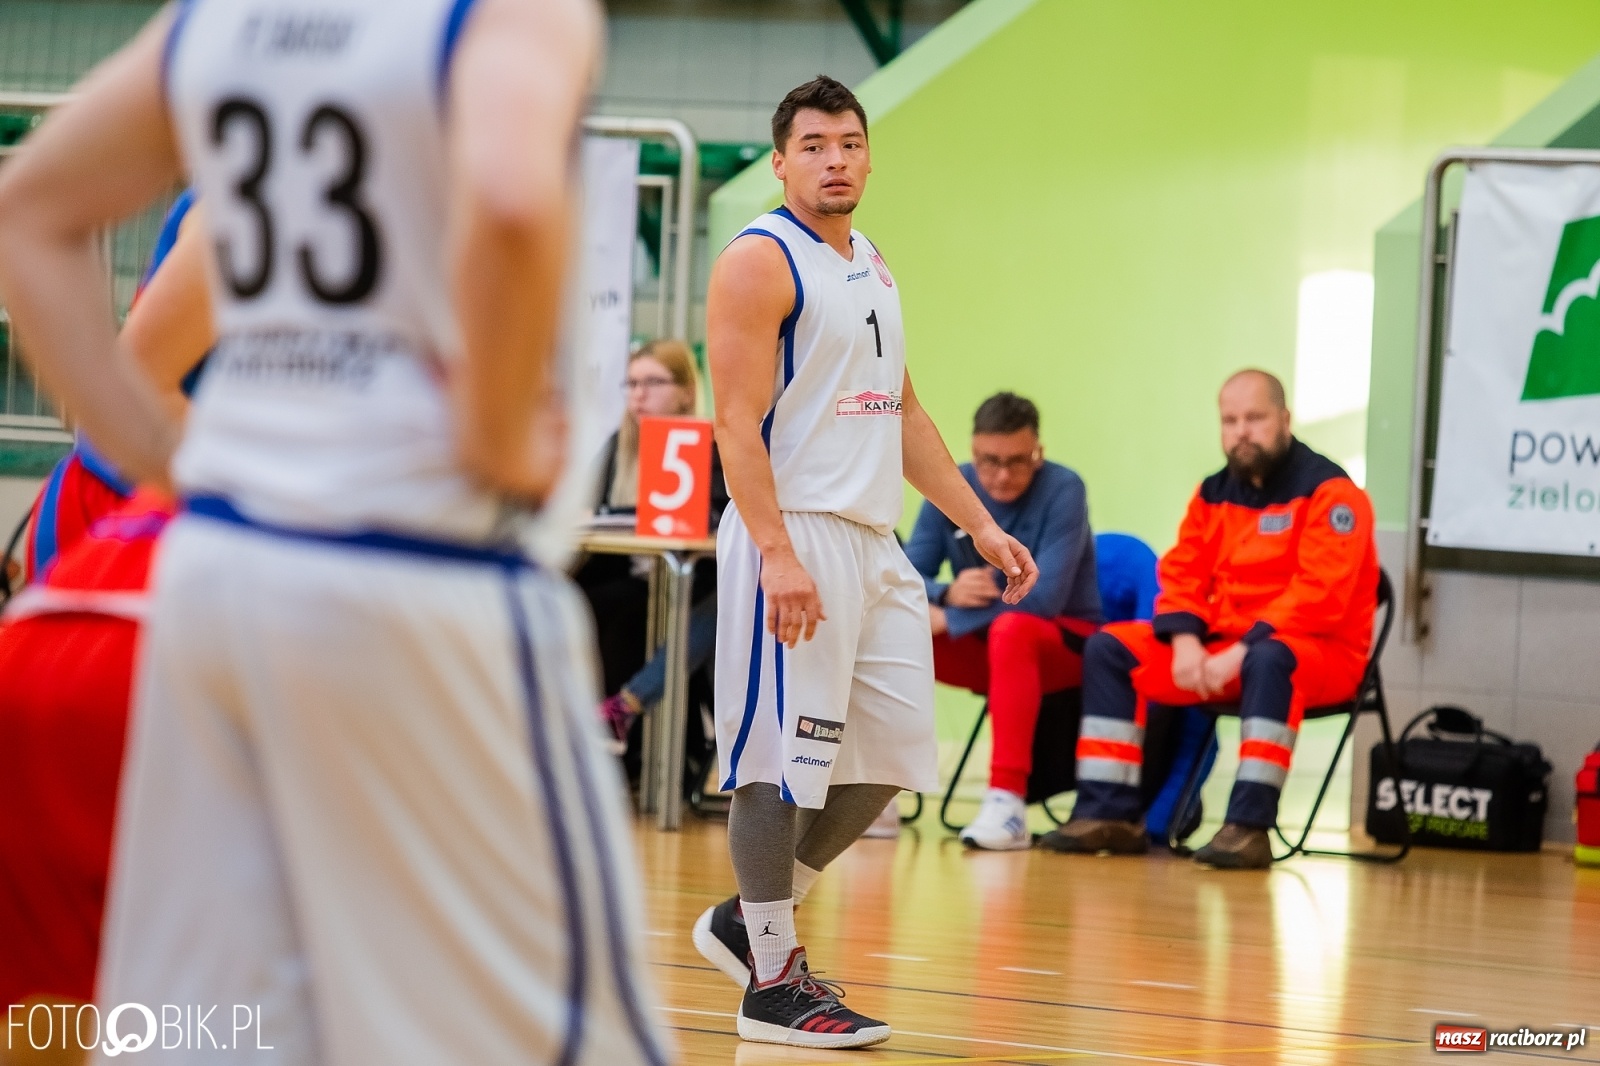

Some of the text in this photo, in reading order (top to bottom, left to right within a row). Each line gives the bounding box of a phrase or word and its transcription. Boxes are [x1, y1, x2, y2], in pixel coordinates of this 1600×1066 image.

[207, 97, 384, 306] 33
[865, 309, 883, 358] 1
[648, 428, 701, 512] 5
[1507, 480, 1600, 513] zielo
[1375, 777, 1493, 823] SELECT
